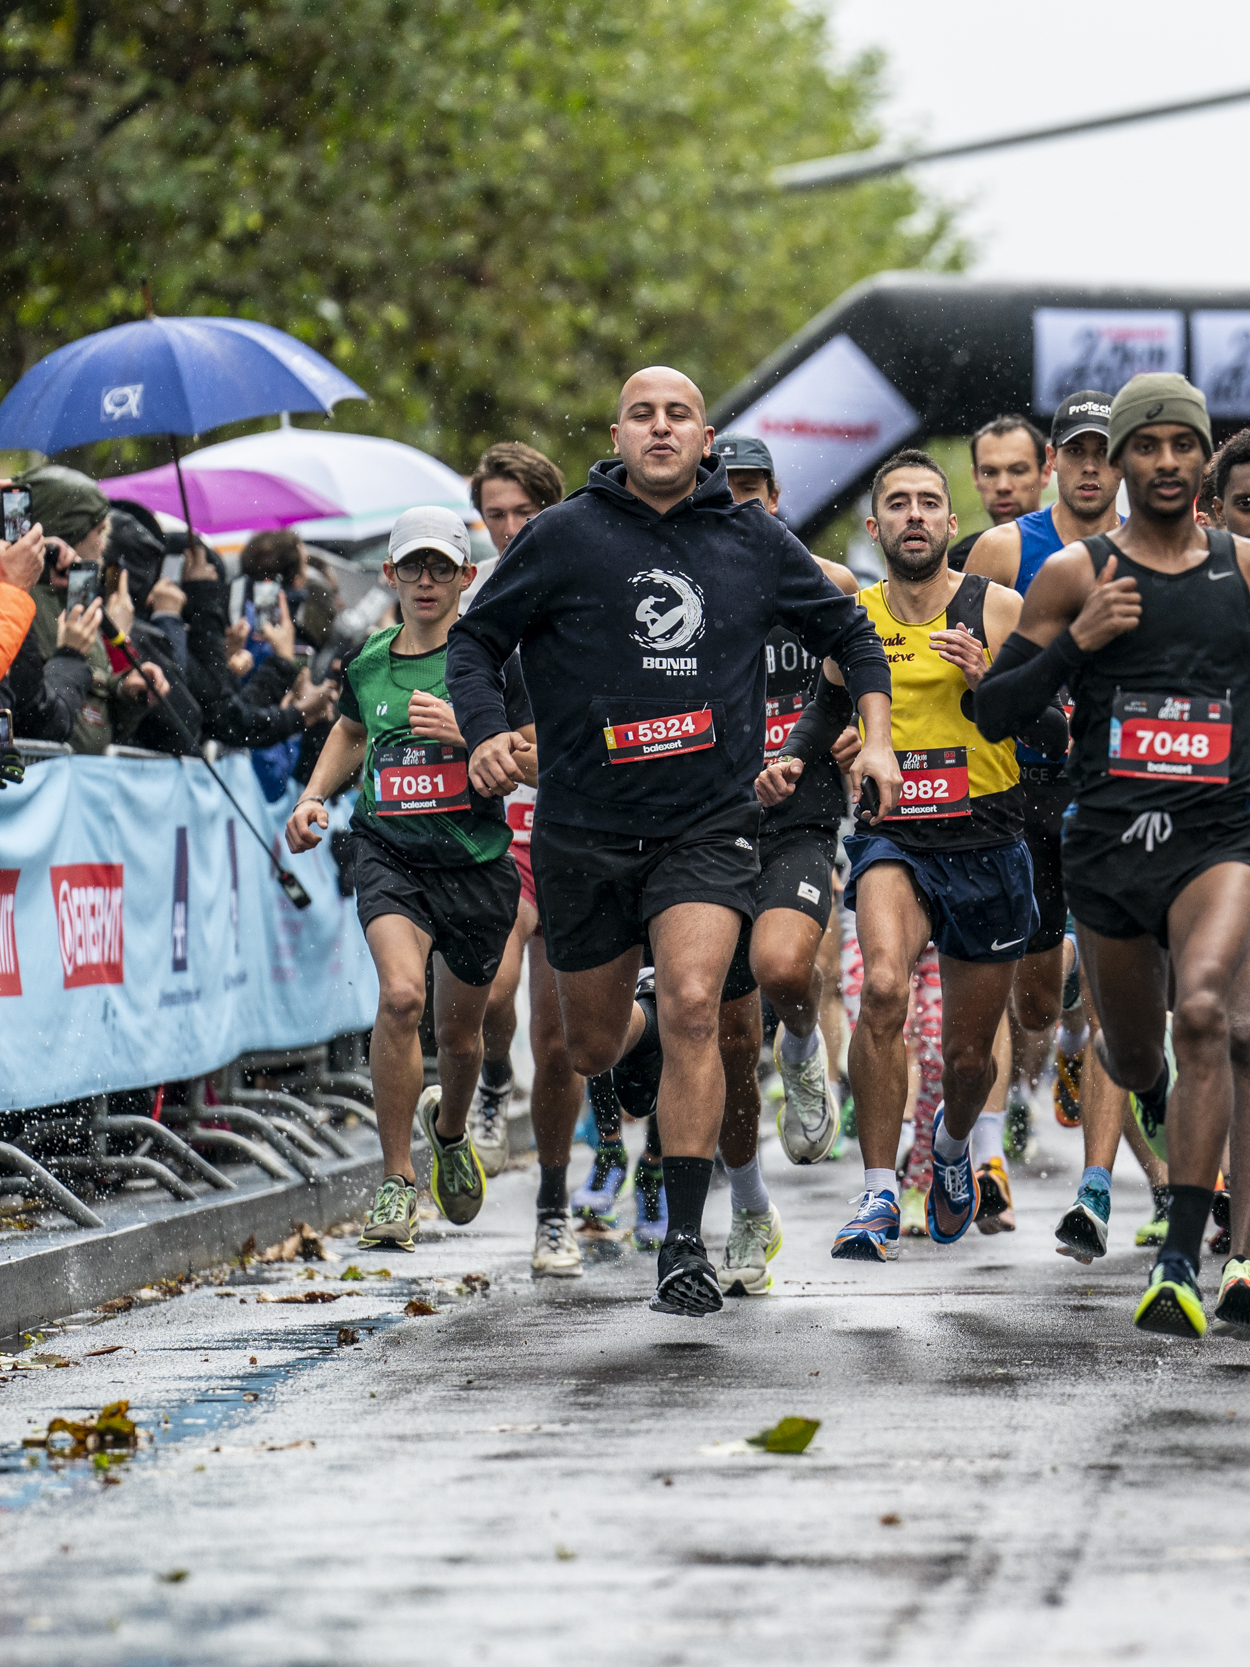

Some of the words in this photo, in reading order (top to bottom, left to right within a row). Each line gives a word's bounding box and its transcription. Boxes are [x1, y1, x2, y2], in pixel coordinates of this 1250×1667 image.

[642, 657, 697, 669] BONDI
[886, 651, 915, 663] nève
[638, 716, 696, 741] 5324
[643, 740, 682, 753] balexert
[1136, 730, 1210, 758] 7048
[390, 774, 445, 795] 7081
[898, 779, 949, 800] 982
[401, 799, 437, 809] balexert
[901, 804, 937, 815] balexert
